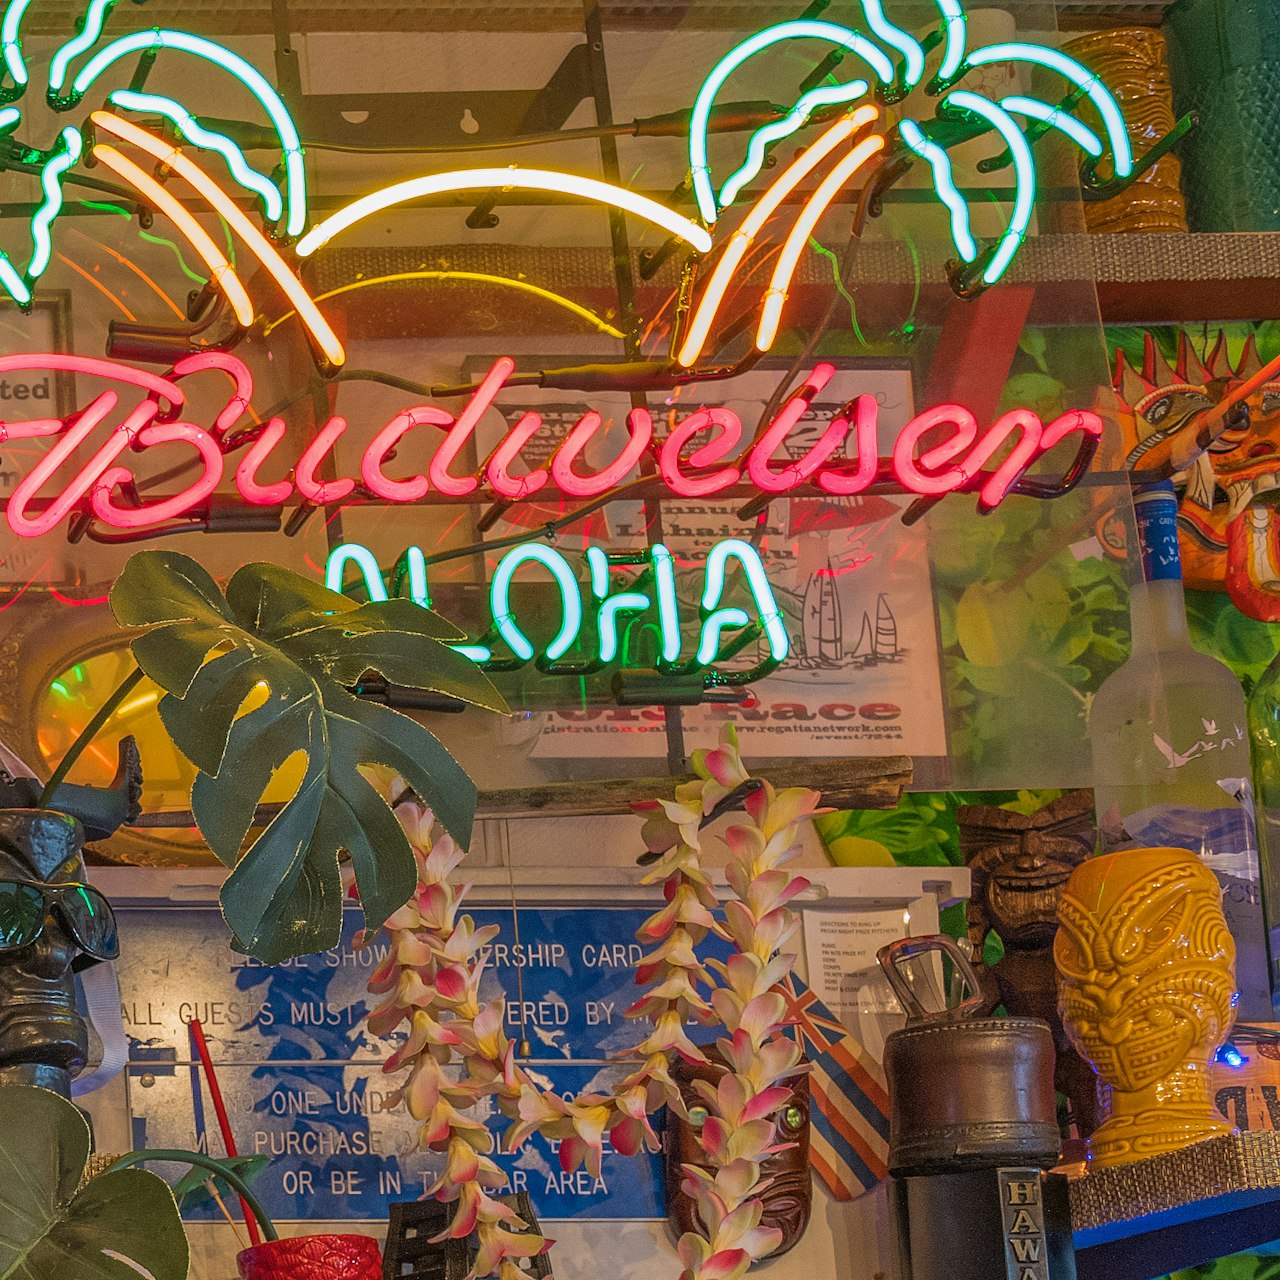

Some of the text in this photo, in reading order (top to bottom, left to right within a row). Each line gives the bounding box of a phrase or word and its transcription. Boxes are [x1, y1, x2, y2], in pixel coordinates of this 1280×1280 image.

[616, 523, 783, 537] Lhaina
[325, 537, 790, 665] ALOHA
[726, 723, 903, 735] ww.regattanetwork.com
[325, 943, 644, 968] SHOW ERSHIP CARD
[178, 1001, 614, 1027] GUESTS MUST BY
[224, 1091, 411, 1117] NO ONE UNDE
[253, 1131, 384, 1156] PURCHASE
[281, 1170, 314, 1195] OR
[329, 1170, 362, 1195] BE
[378, 1171, 402, 1195] IN
[544, 1171, 608, 1195] AREA
